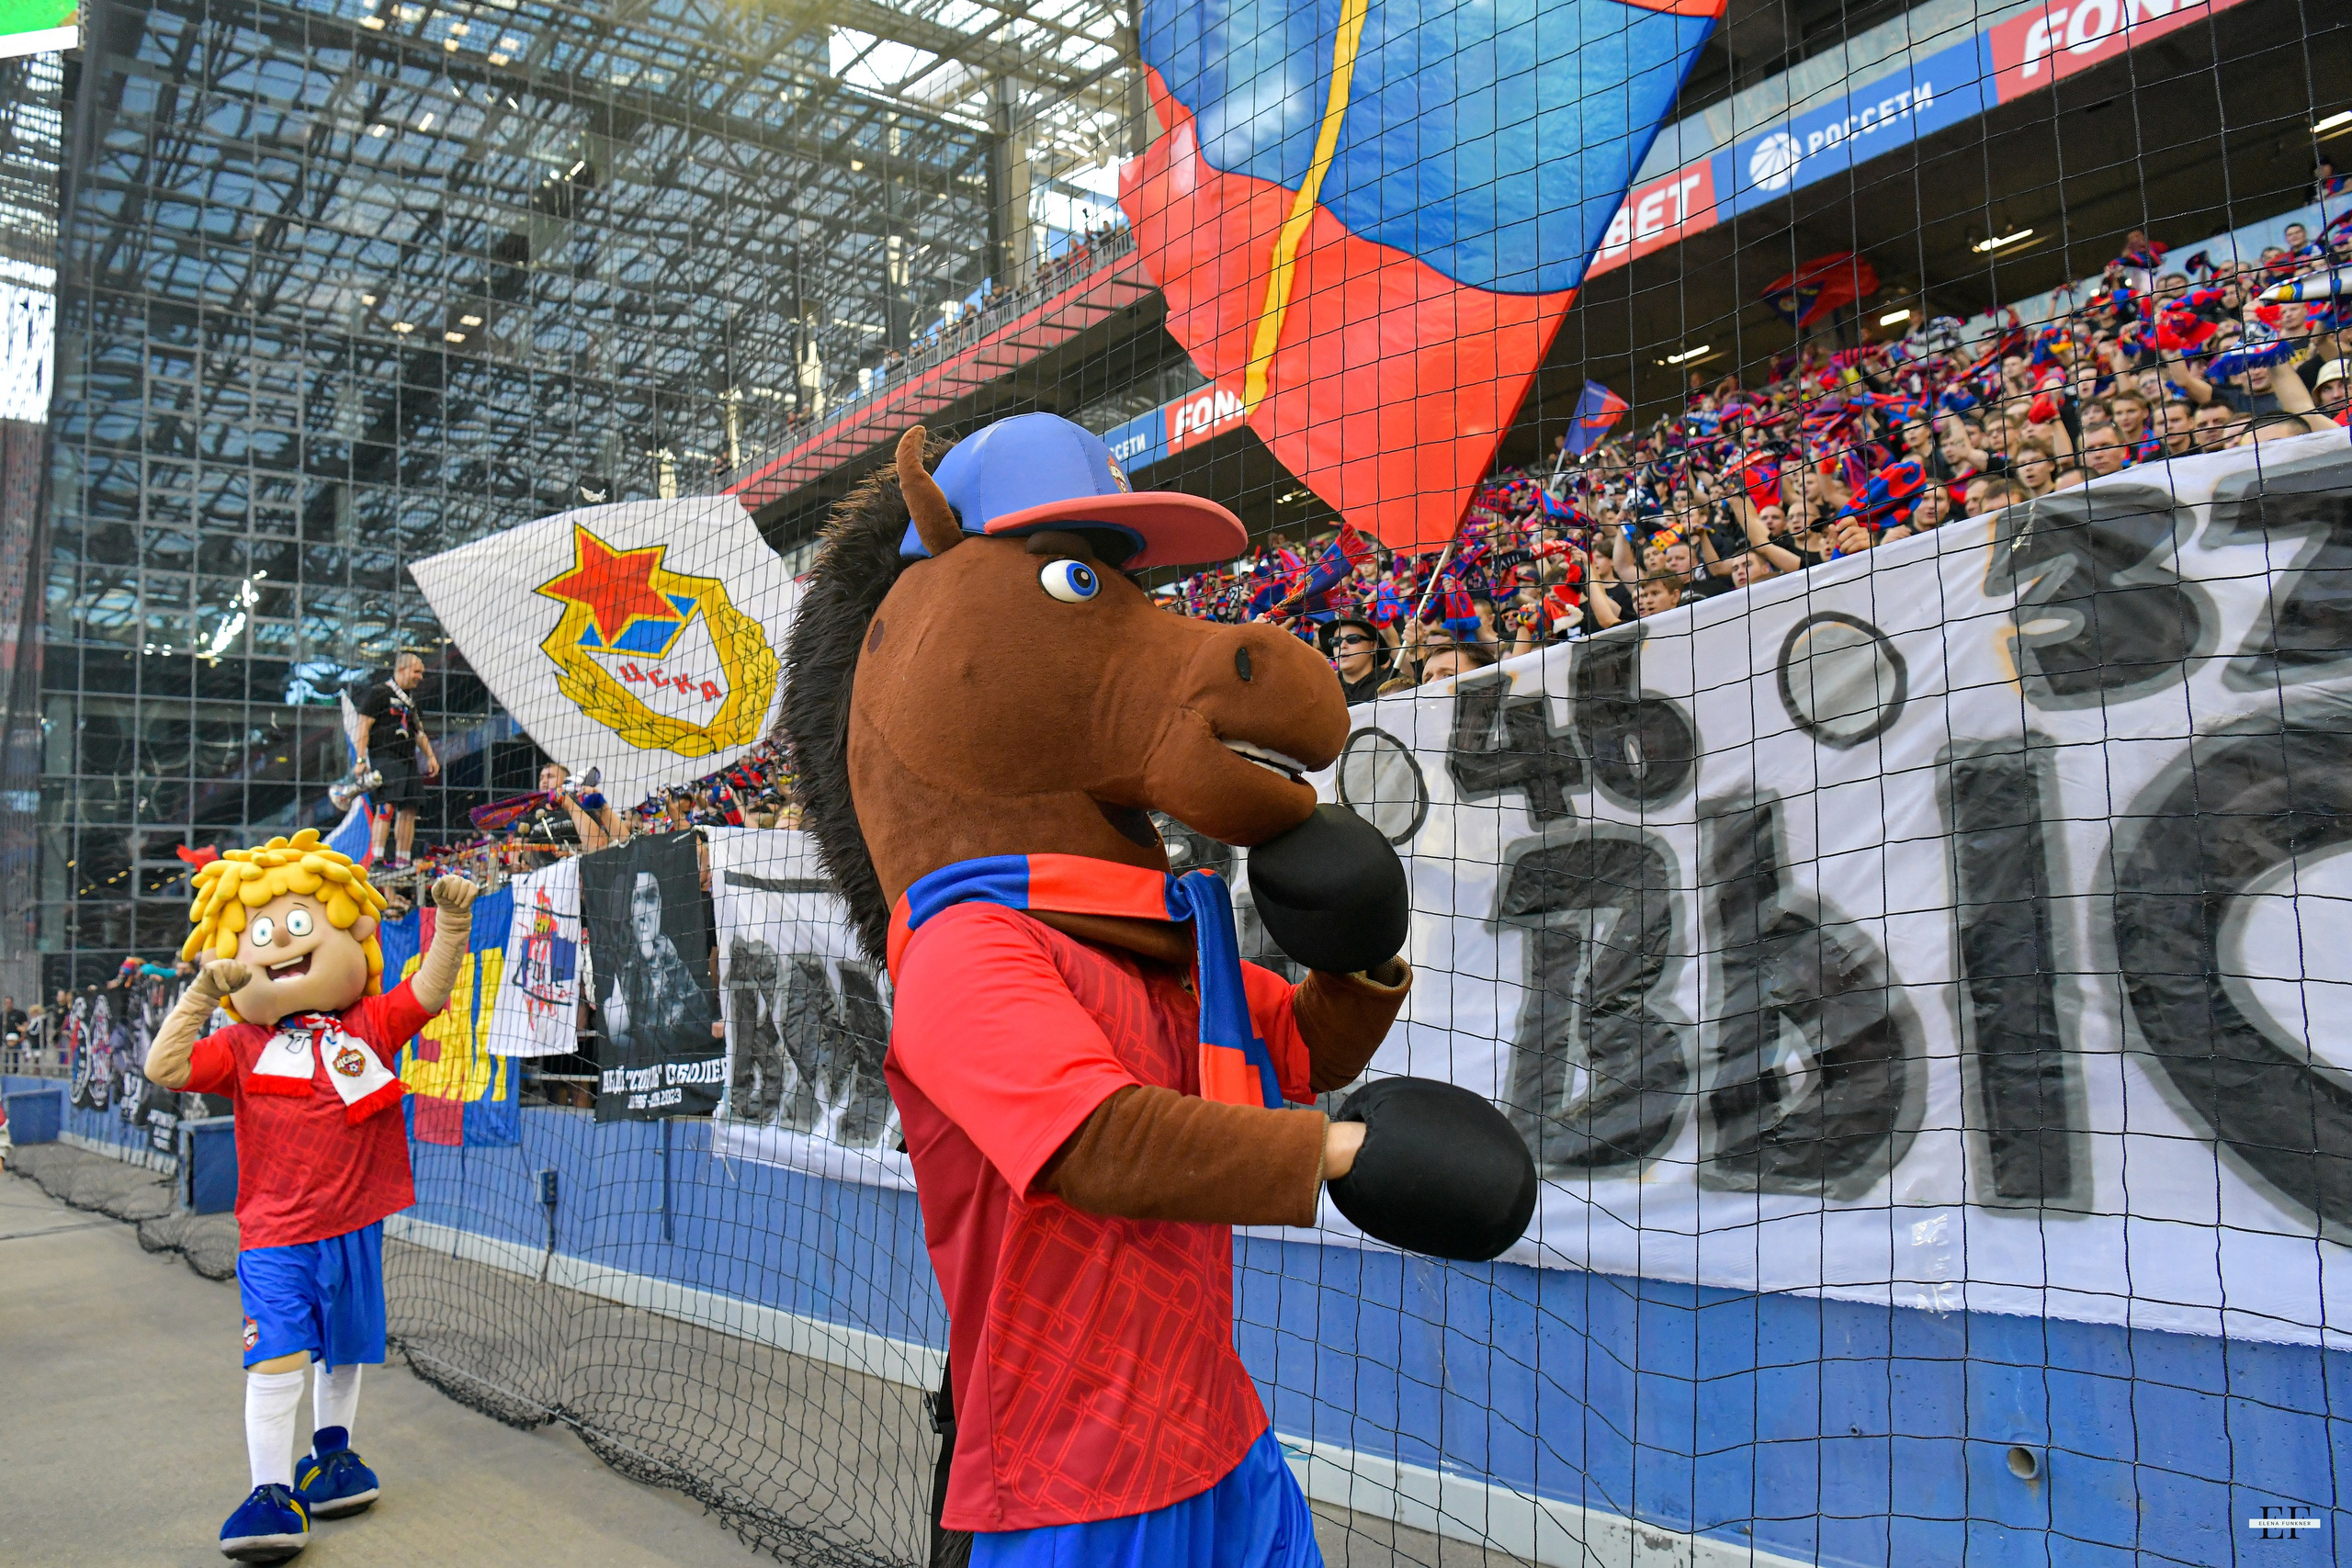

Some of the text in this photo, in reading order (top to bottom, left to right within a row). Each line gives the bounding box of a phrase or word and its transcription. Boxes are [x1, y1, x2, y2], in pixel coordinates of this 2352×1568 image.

[1807, 81, 1934, 158] РОССЕТИ
[1590, 173, 1701, 266] BET
[618, 662, 722, 702] ЦСКА
[1445, 623, 1703, 832] 46
